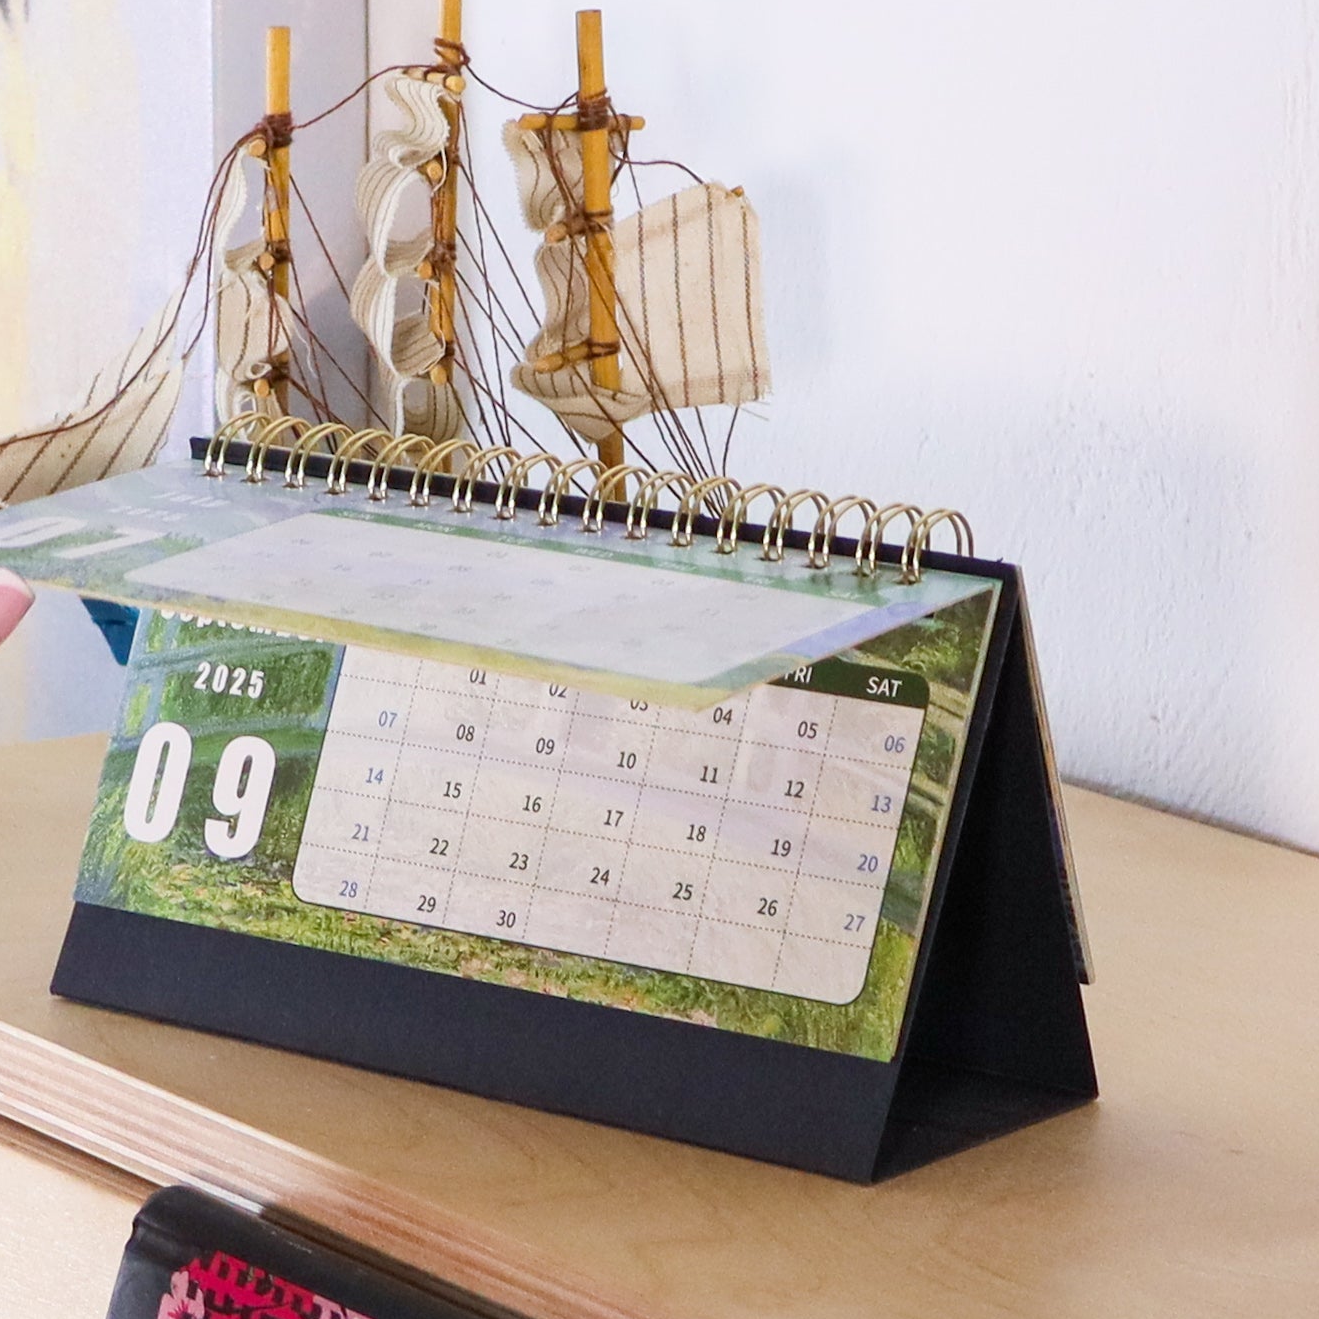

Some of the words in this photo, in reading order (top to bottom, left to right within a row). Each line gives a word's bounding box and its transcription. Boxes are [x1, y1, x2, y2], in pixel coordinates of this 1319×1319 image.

[193, 661, 266, 700] 2025
[469, 668, 487, 686] 01
[713, 707, 733, 725] 04
[797, 721, 818, 740] 05
[884, 735, 906, 754] 06
[866, 676, 903, 698] SAT
[123, 721, 277, 860] 09
[378, 710, 398, 728] 07
[456, 723, 475, 742] 08
[535, 737, 555, 755] 09
[617, 751, 637, 770] 10
[700, 765, 719, 784] 11
[784, 780, 805, 799] 12
[871, 795, 892, 813] 13
[366, 767, 384, 784] 14
[442, 781, 462, 799] 15
[522, 795, 542, 813] 16
[604, 809, 624, 828] 17
[686, 824, 707, 842] 18
[771, 839, 792, 857] 19
[857, 854, 879, 873] 20
[339, 880, 358, 899] 28
[417, 895, 436, 914] 29
[496, 909, 517, 928] 30
[352, 823, 370, 842] 21
[429, 838, 450, 856] 22
[509, 852, 529, 871] 23
[590, 867, 610, 886] 24
[673, 883, 693, 901] 25
[757, 897, 778, 916] 26
[844, 913, 865, 933] 27
